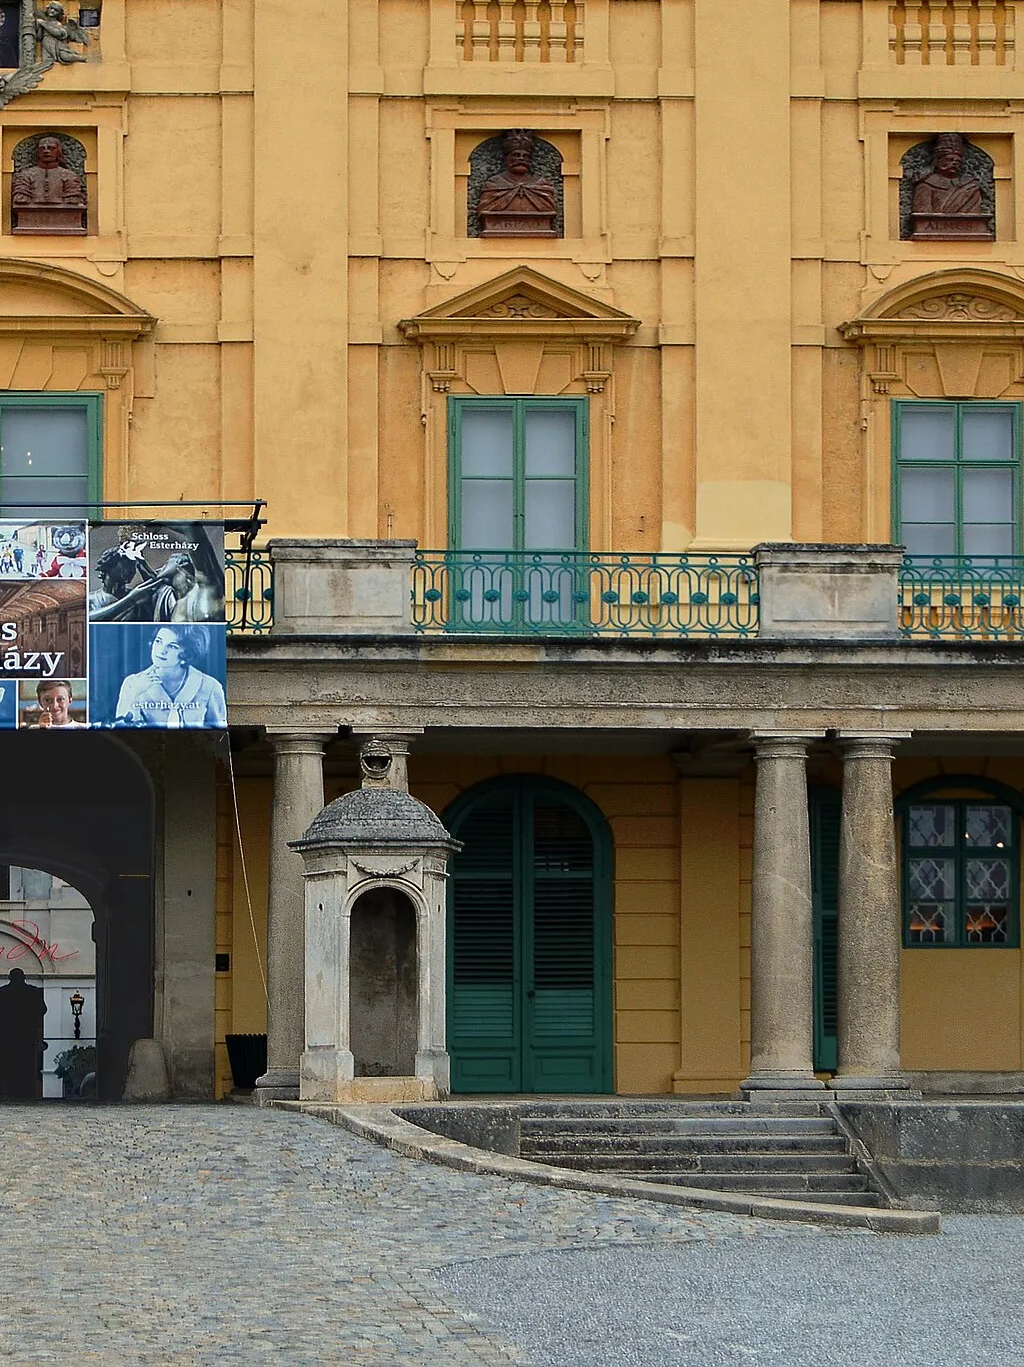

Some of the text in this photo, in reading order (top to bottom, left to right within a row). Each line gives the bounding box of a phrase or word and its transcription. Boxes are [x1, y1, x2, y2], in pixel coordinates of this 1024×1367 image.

[131, 532, 169, 541] Schloss
[149, 541, 200, 551] Esterházy
[132, 700, 201, 711] esterhazy.at
